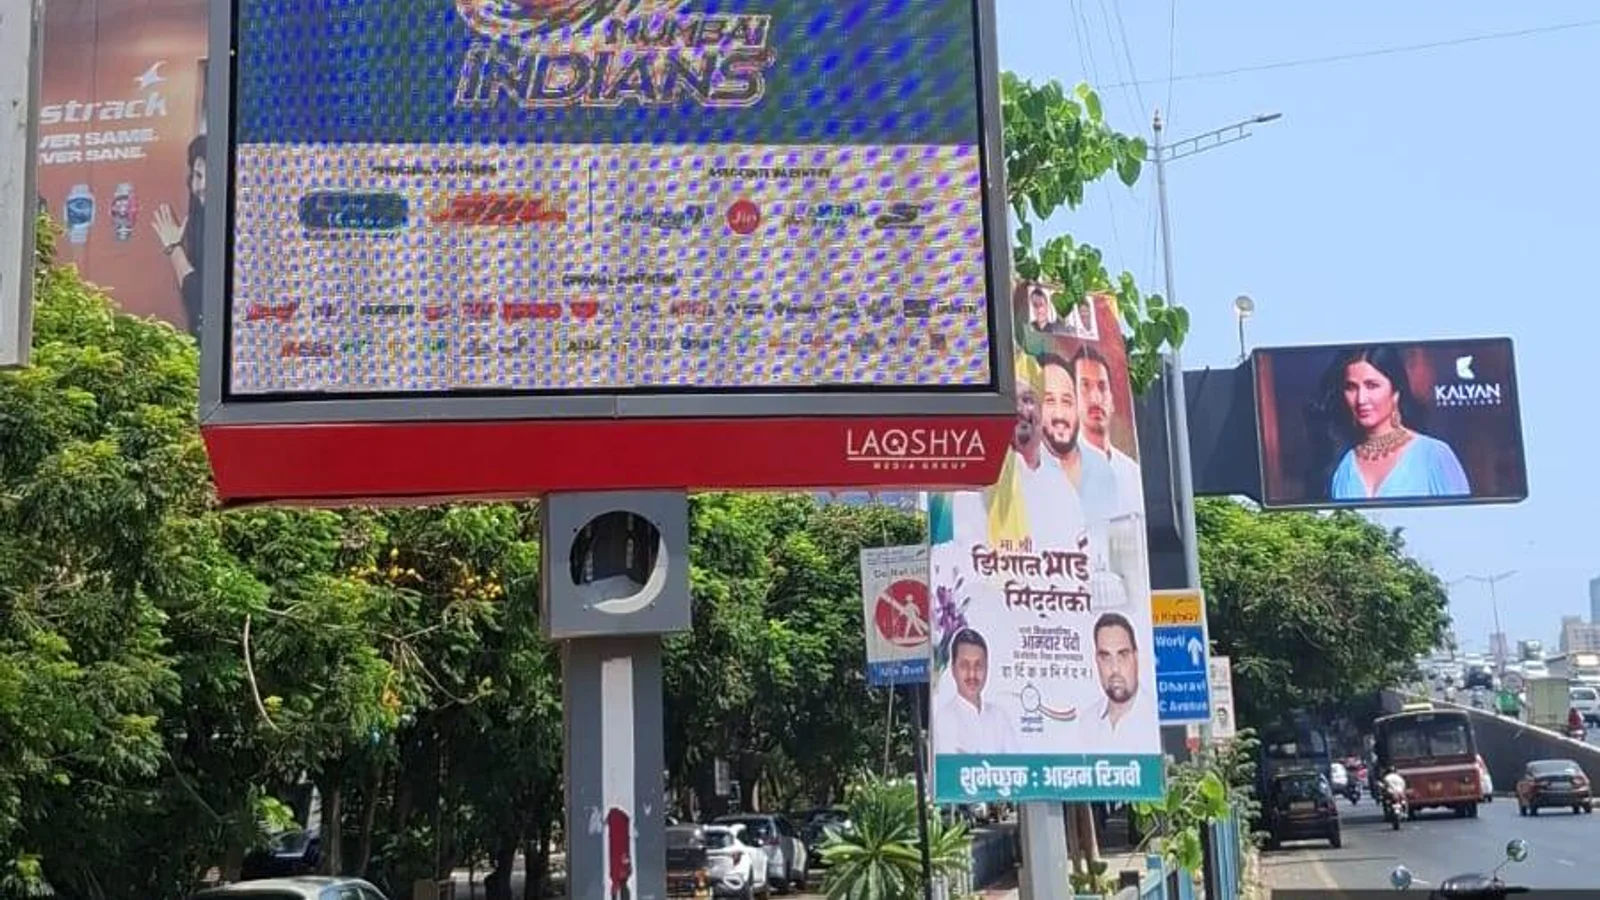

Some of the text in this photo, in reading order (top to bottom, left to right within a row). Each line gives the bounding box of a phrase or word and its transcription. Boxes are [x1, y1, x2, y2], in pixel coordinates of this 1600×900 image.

[604, 13, 771, 49] MUMBAI
[454, 43, 776, 108] INDIANS
[40, 92, 167, 124] strack
[85, 128, 159, 146] SAME.
[86, 146, 147, 161] SANE.
[1435, 383, 1500, 400] KALYAN
[847, 429, 986, 455] LAQSHYA
[1155, 635, 1185, 648] Worli
[1159, 679, 1206, 692] Dharavi
